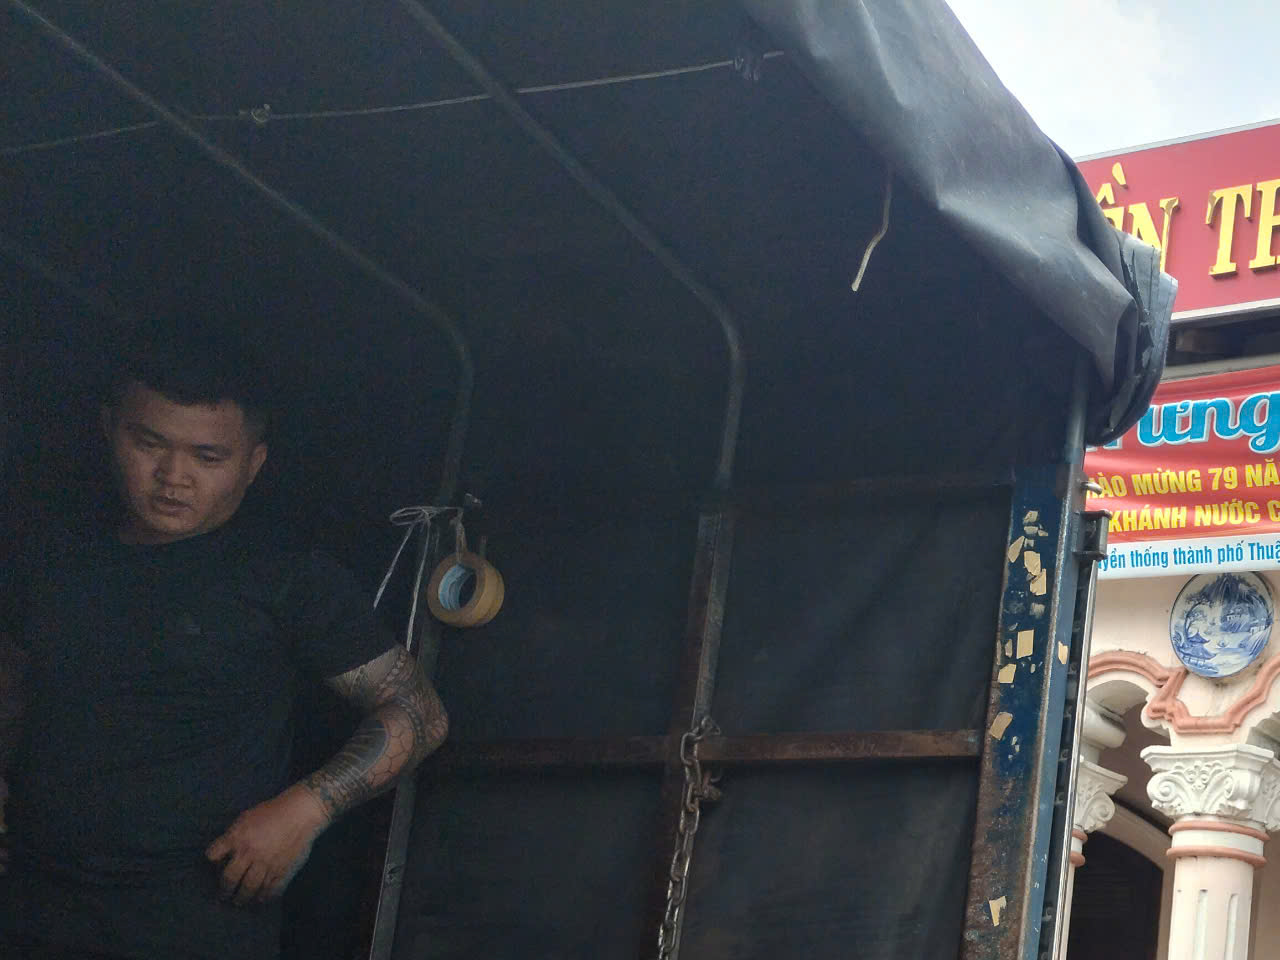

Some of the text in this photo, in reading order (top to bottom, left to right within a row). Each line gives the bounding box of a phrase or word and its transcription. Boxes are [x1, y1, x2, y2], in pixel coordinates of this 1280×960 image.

[1131, 468, 1202, 496] MỪNG
[1208, 466, 1239, 491] 79
[1108, 504, 1188, 533] KHÁNH
[1194, 499, 1261, 527] NƯỚC
[1130, 546, 1169, 569] thống
[1174, 545, 1213, 565] thành
[1217, 540, 1245, 564] phố
